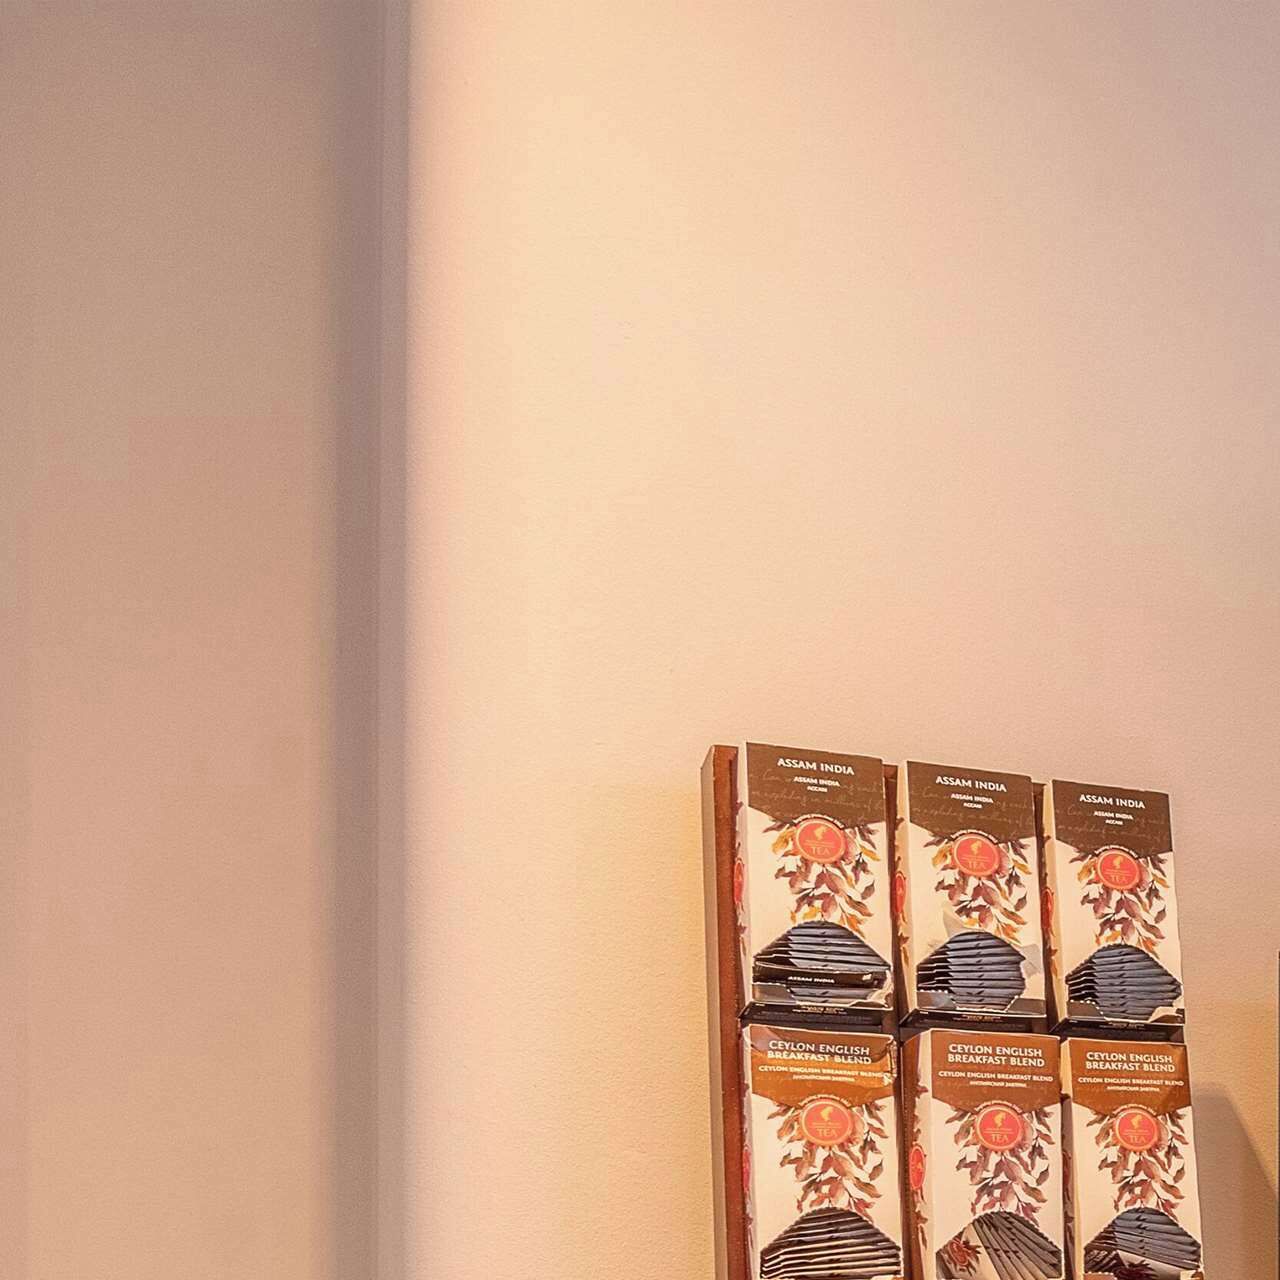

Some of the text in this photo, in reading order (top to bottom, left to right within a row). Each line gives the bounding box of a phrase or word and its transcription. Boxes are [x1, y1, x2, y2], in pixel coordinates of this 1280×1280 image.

[777, 757, 855, 776] ASSAM INDIA
[935, 775, 1007, 793] ASSAM INDIA
[1079, 794, 1145, 809] ASSAM INDIA
[768, 1040, 870, 1056] CEYLON ENGLISH
[949, 1043, 1042, 1057] CEYLON ENGLISH
[767, 1050, 872, 1065] BREAKFAST BLEND
[947, 1054, 1045, 1068] BREAKFAST BLEND
[1086, 1051, 1173, 1063] CEYLON ENGLISH
[1085, 1061, 1176, 1073] BREAKFAST BLEND
[967, 1071, 996, 1079] ENGLISH
[997, 1073, 1032, 1081] BREAKFAST
